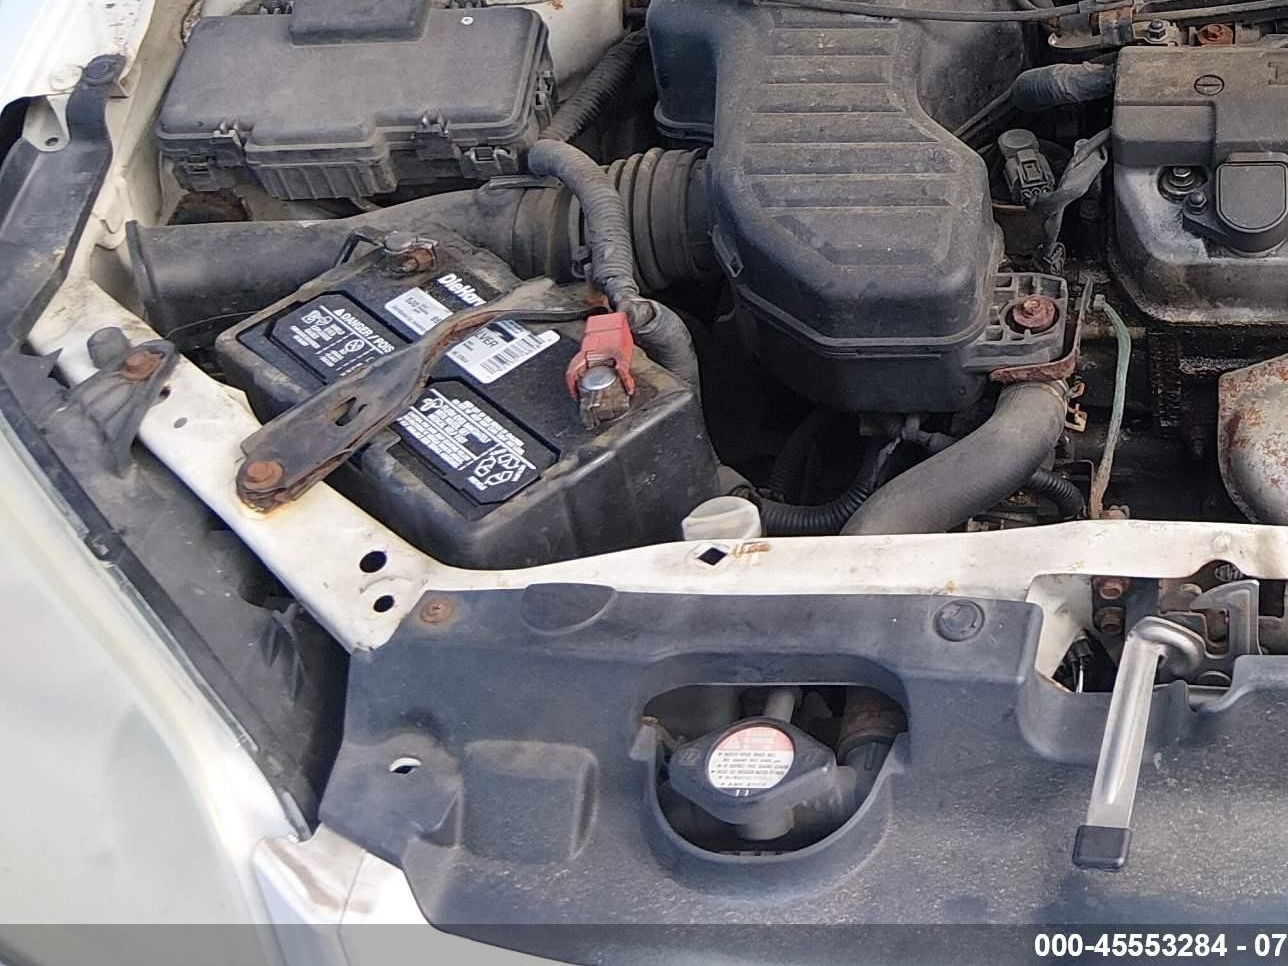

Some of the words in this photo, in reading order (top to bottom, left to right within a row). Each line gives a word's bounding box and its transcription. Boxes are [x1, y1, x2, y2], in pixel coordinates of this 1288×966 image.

[437, 273, 488, 306] DieHar
[341, 313, 373, 338] DANGER
[373, 337, 395, 354] POIS
[477, 330, 499, 348] LVER
